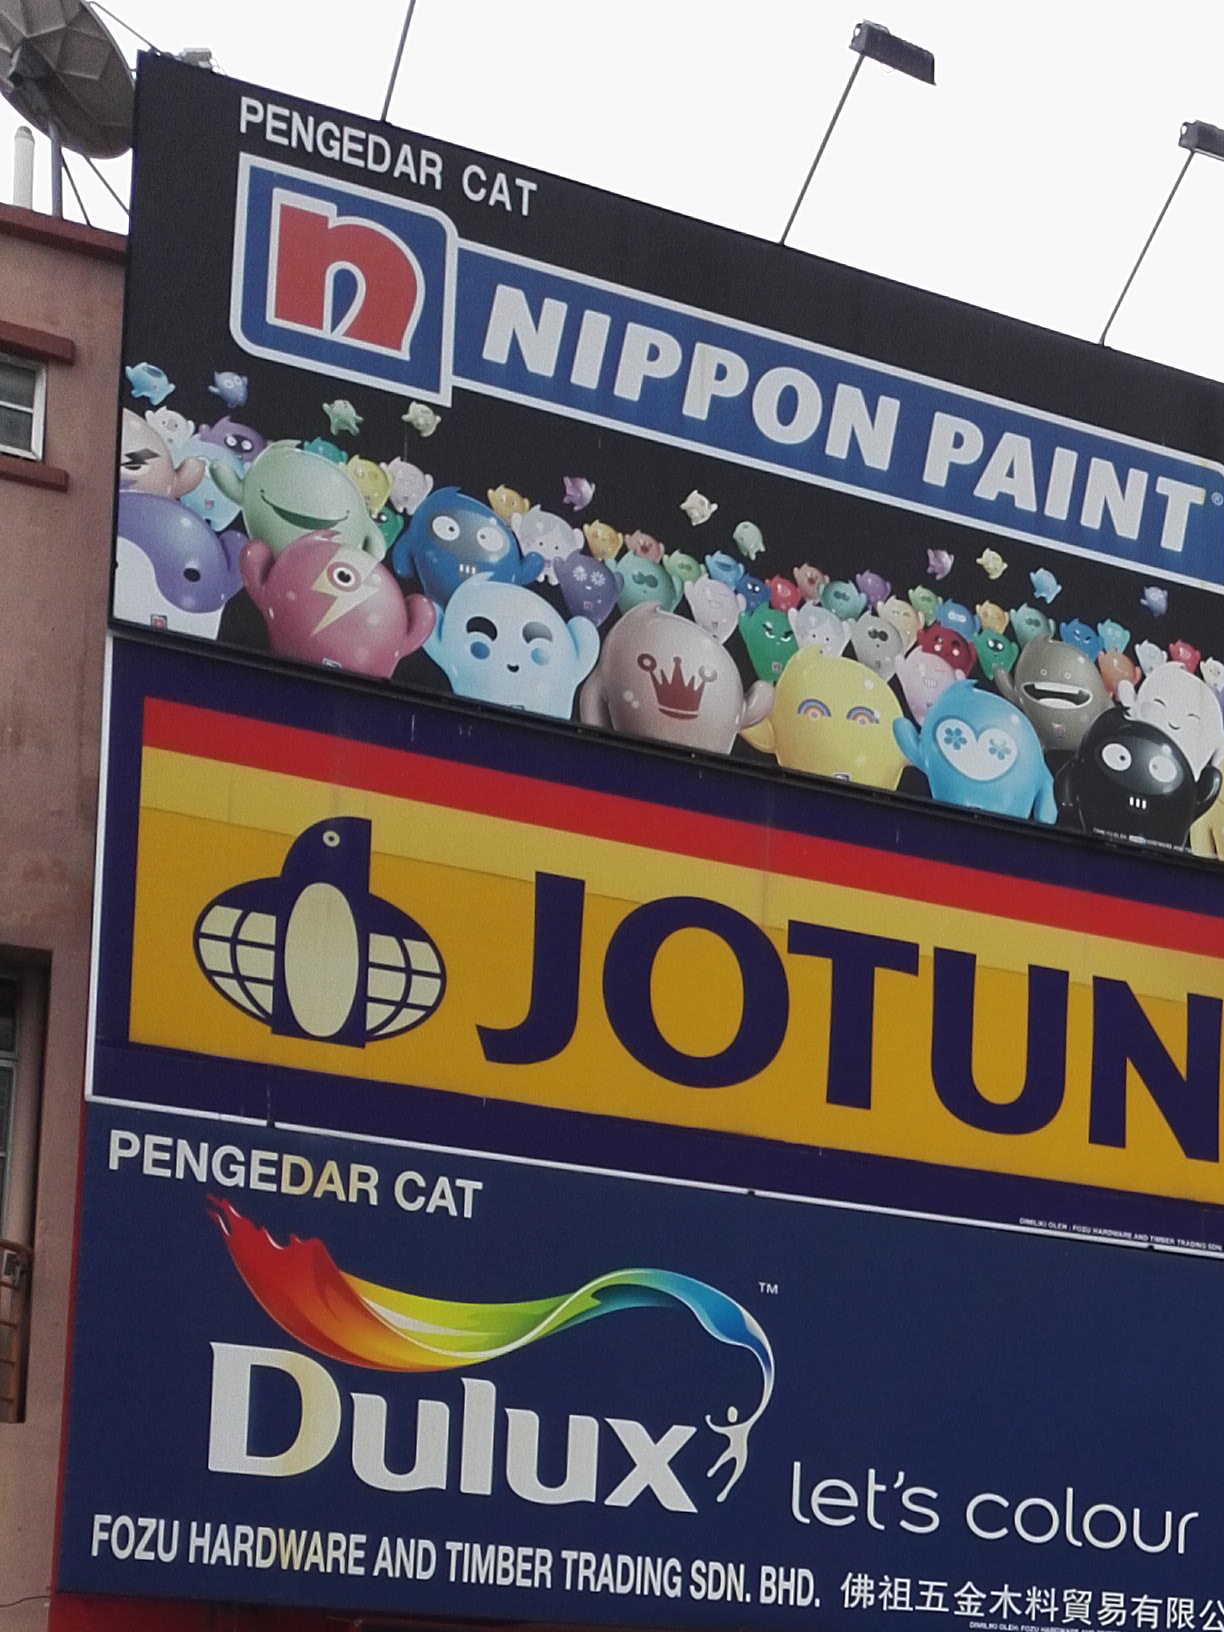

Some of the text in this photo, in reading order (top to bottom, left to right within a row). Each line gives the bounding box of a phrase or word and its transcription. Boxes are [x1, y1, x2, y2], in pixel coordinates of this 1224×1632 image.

[240, 97, 538, 216] PENGEDAR CAT
[483, 284, 1206, 552] NIPPON PAINT
[478, 871, 1222, 1161] JOTUN
[108, 1129, 483, 1219] PENGEDAR CAT
[207, 1341, 698, 1513] Dulux
[91, 1513, 179, 1562] FOZU
[189, 1520, 366, 1576] HARDWARE
[374, 1536, 436, 1581] AND
[445, 1540, 551, 1588] TIMBER
[562, 1550, 682, 1598] TRADING
[689, 1559, 751, 1603] SDN.
[760, 1565, 821, 1608] BHD.
[790, 1461, 1199, 1555] let's colour
